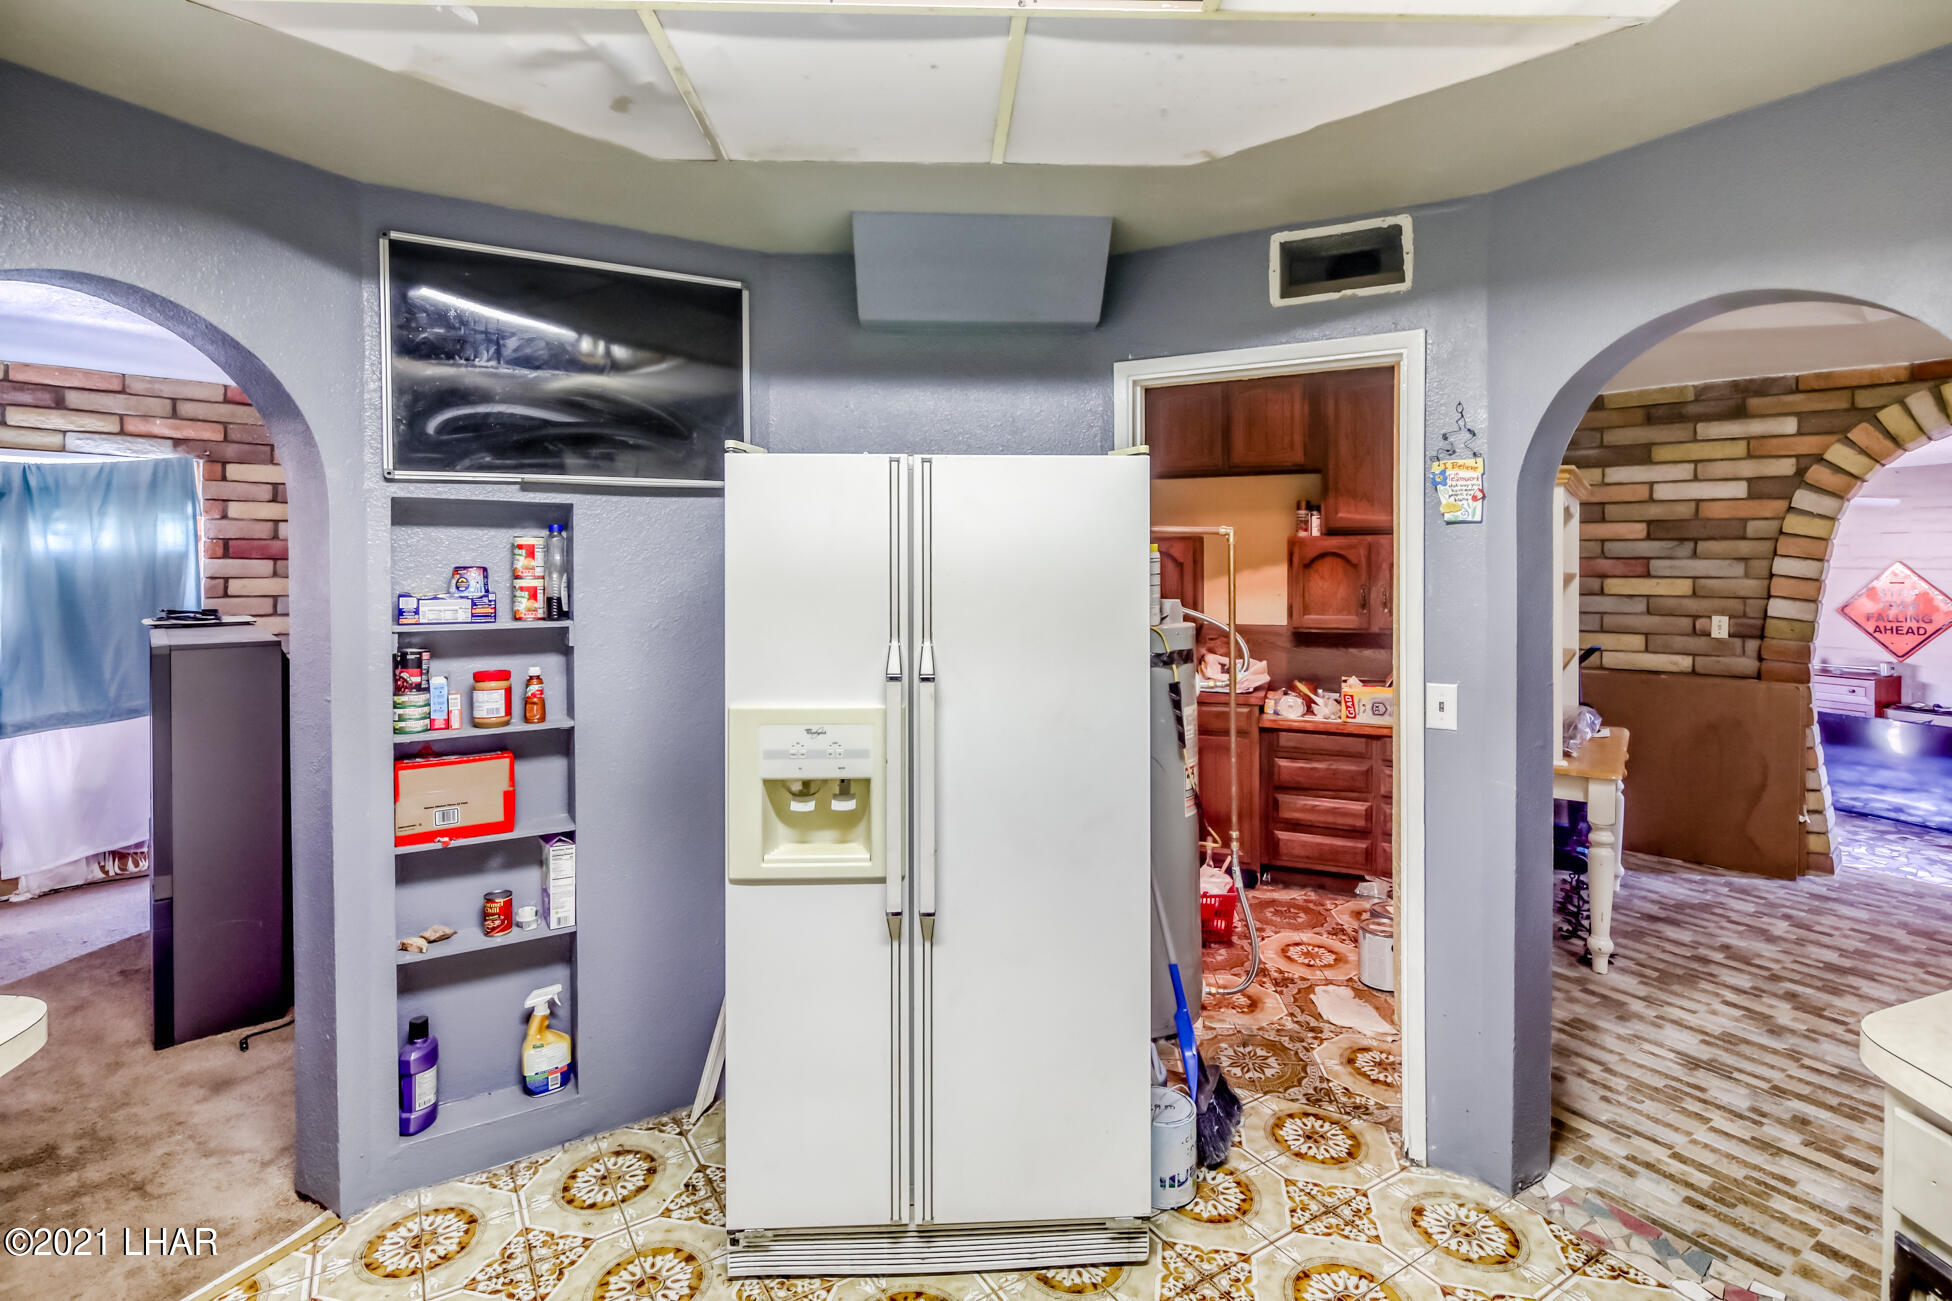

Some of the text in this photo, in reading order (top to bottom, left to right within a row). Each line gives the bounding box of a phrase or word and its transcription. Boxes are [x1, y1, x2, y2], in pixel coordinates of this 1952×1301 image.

[1442, 462, 1479, 472] I Believe
[1866, 612, 1933, 624] FALLING
[1873, 625, 1928, 636] AHEAD
[1345, 695, 1355, 718] GLAD
